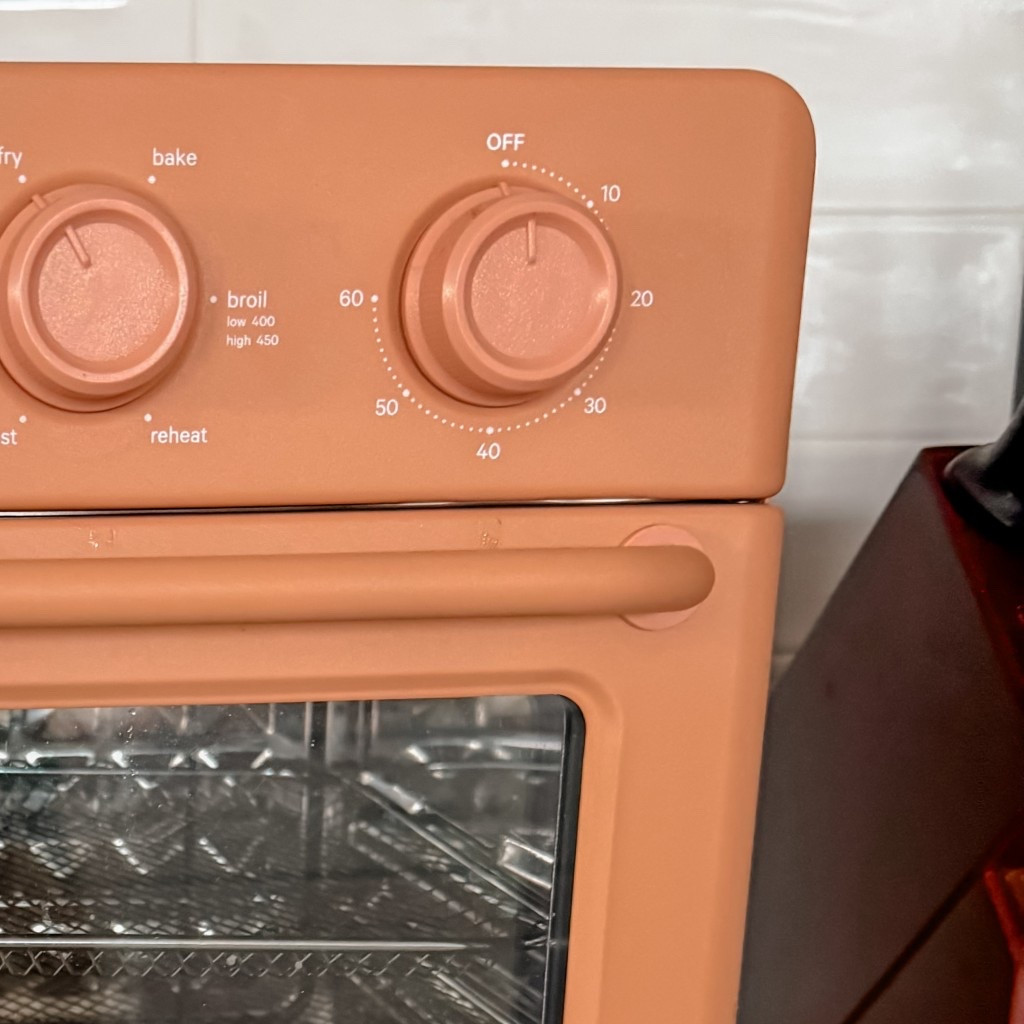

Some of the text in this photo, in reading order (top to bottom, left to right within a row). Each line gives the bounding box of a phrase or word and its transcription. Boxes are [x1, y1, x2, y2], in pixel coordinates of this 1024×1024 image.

[486, 133, 525, 152] OFF
[152, 148, 197, 167] bake
[600, 185, 620, 203] 10
[227, 290, 267, 309] broil
[339, 289, 364, 308] 60
[630, 290, 653, 308] 20
[226, 316, 275, 328] low 400
[225, 334, 279, 349] high 450
[375, 399, 398, 417] 50
[583, 397, 606, 414] 30
[150, 426, 207, 444] reheat
[475, 442, 501, 460] 40
